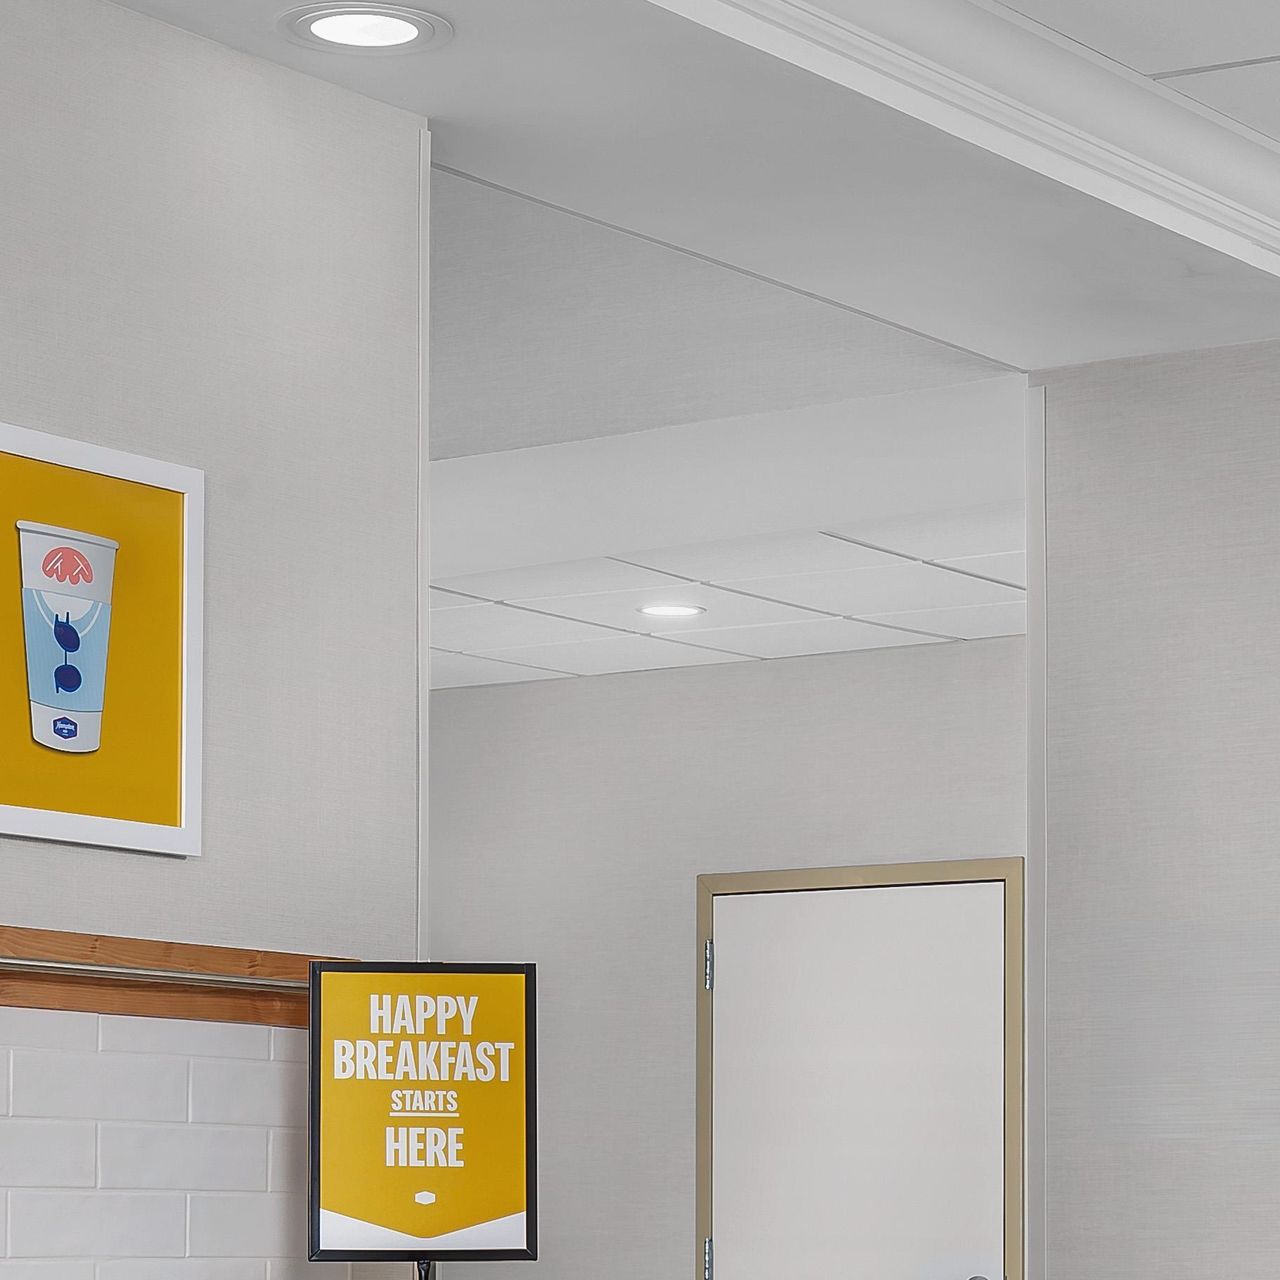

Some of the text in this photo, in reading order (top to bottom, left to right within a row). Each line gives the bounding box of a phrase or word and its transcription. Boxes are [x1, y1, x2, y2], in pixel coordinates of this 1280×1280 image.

[370, 994, 478, 1035] HAPPY
[333, 1040, 514, 1081] BREAKFAST
[391, 1090, 458, 1111] STARTS
[385, 1126, 464, 1167] HERE
